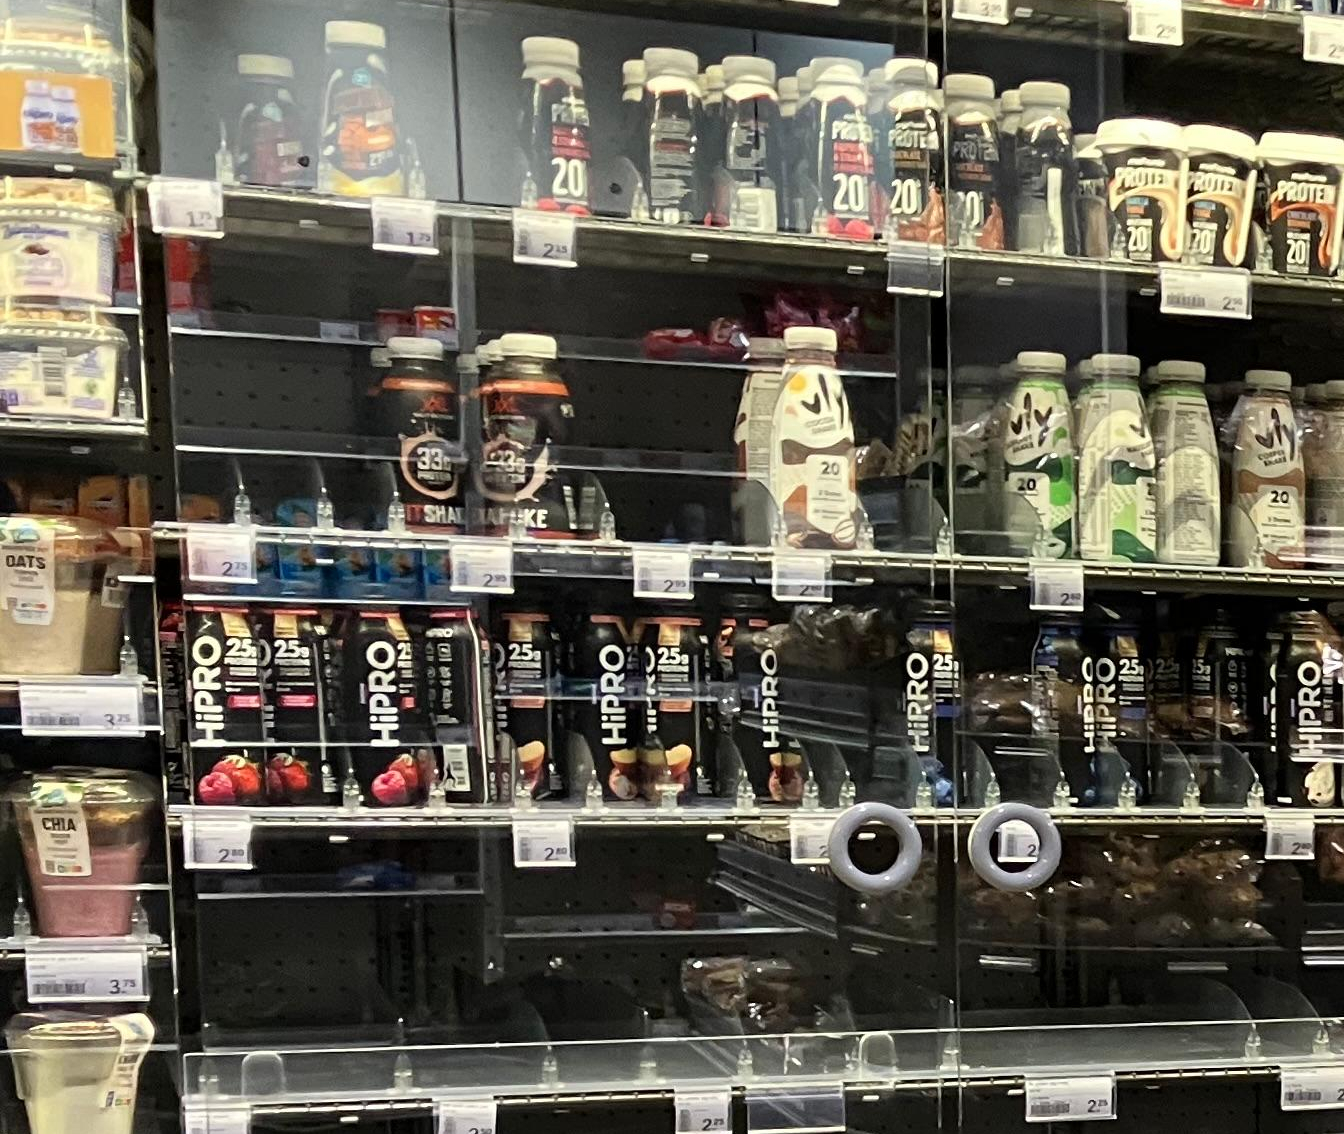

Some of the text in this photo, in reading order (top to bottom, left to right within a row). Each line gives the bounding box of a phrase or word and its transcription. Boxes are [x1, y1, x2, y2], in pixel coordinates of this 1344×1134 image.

[820, 461, 840, 476] 20
[1017, 477, 1037, 491] 20
[1270, 490, 1290, 504] 20
[5, 554, 46, 570] OATS
[273, 640, 310, 659] 25g
[508, 643, 542, 661] 25g
[657, 647, 689, 665] 25g
[191, 635, 226, 747] HiPRO
[366, 640, 400, 747] HiPRO
[599, 644, 628, 745] HiPRO
[761, 649, 781, 749] HiPRO
[906, 652, 930, 752] HiPRO
[41, 816, 77, 833] CHIA
